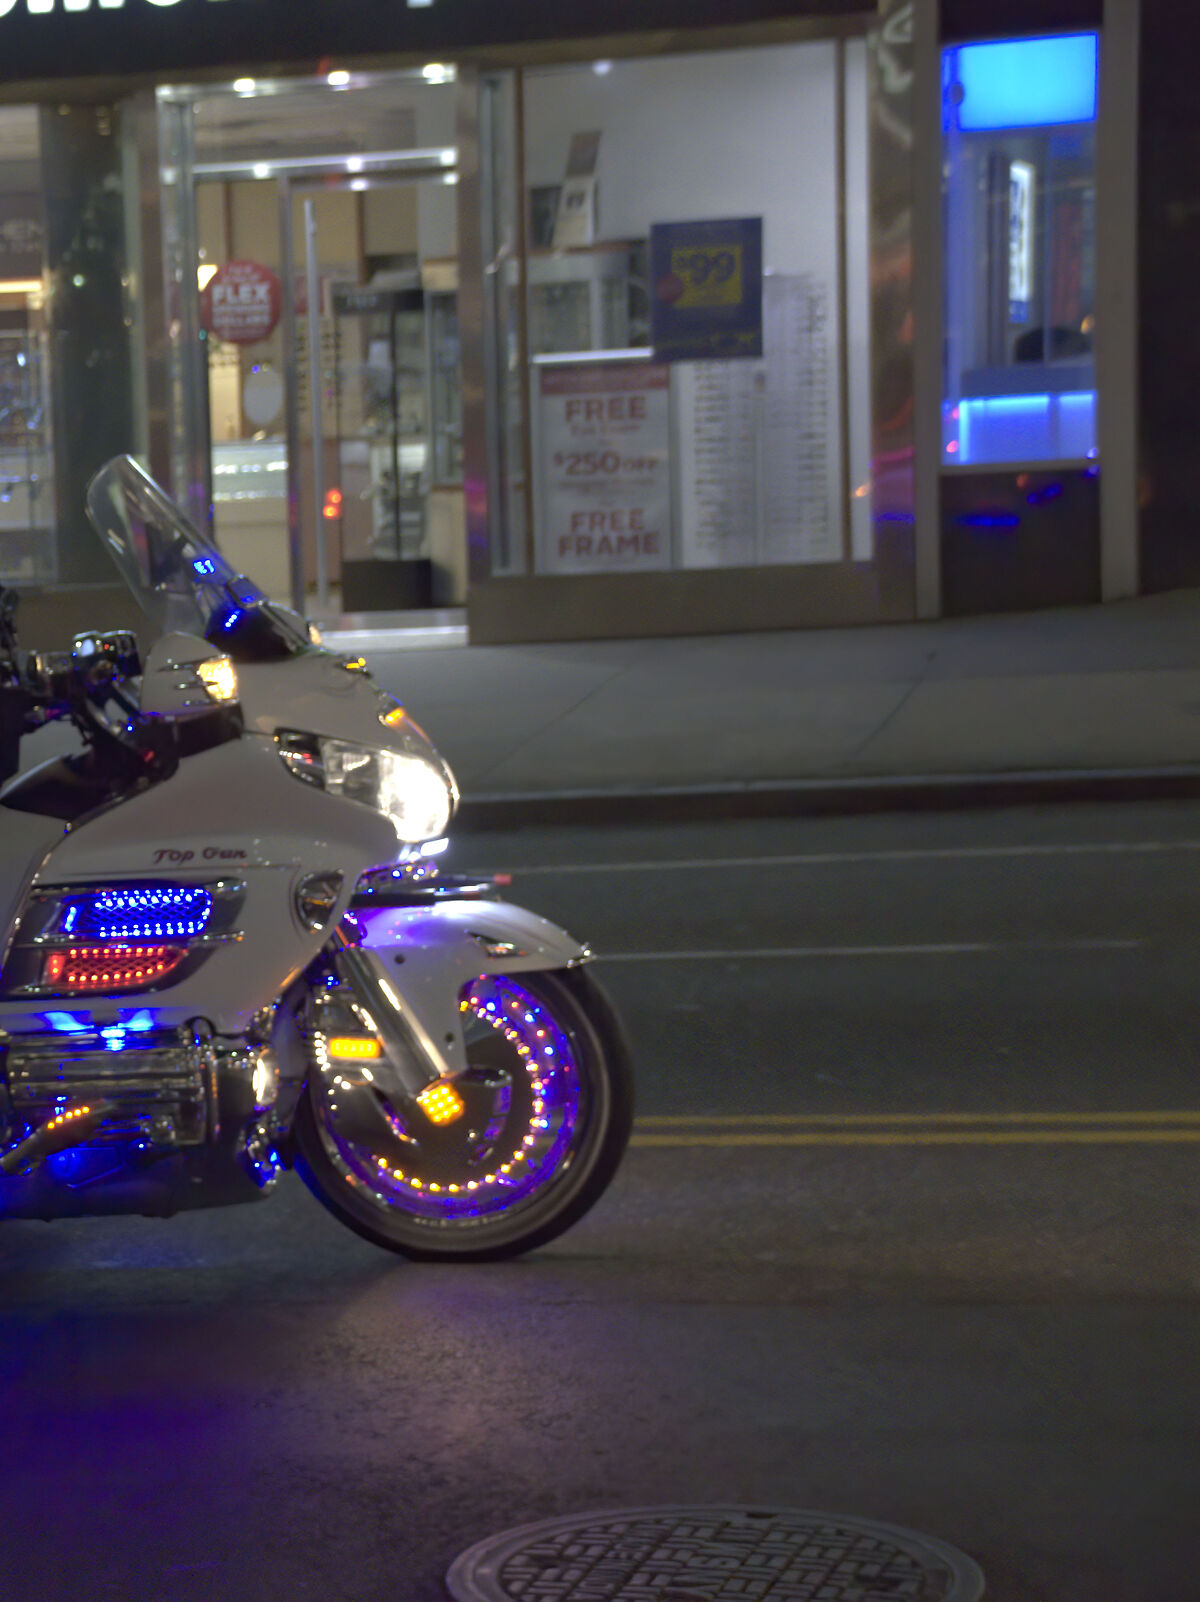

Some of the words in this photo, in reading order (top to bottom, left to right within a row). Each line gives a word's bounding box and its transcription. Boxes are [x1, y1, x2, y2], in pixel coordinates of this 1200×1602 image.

[212, 283, 270, 305] FLEX
[565, 395, 647, 423] FREE
[553, 450, 621, 475] $250
[570, 508, 645, 533] FREE
[557, 530, 660, 558] FRAME
[153, 848, 195, 865] Top
[202, 846, 247, 860] Gun
